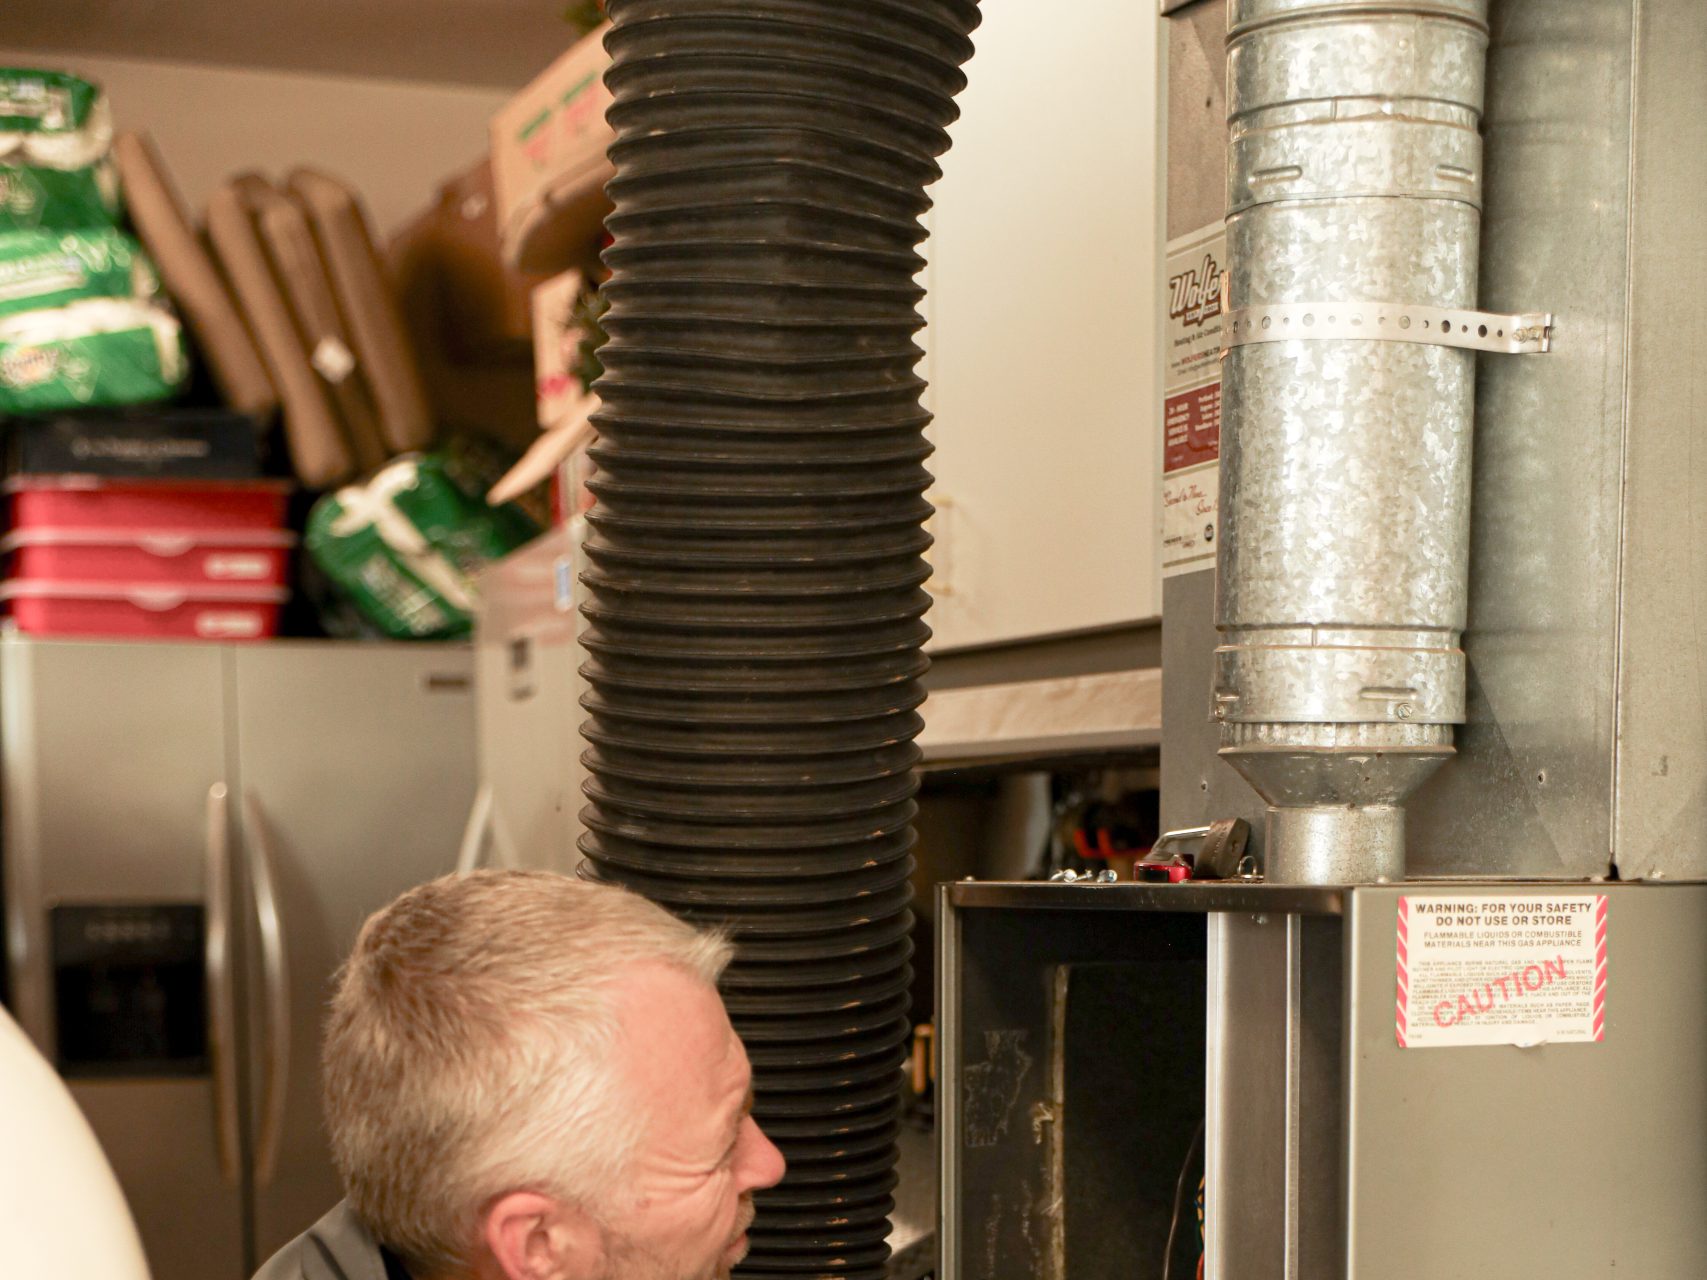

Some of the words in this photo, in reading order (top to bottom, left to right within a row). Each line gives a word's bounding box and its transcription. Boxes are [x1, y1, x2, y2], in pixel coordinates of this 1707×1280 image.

[1415, 903, 1478, 914] WARNING:
[1481, 903, 1506, 914] FOR
[1509, 903, 1543, 914] YOUR
[1546, 903, 1592, 913] SAFETY
[1436, 916, 1453, 926] DO
[1456, 916, 1481, 926] NOT
[1484, 916, 1508, 926] USE
[1512, 916, 1529, 926] OR
[1532, 915, 1572, 926] STORE
[1423, 931, 1474, 940] FLAMMABLE
[1476, 931, 1509, 939] LIQUIDS
[1511, 931, 1522, 939] OR
[1524, 930, 1582, 939] COMBUSTIBLE
[1424, 940, 1471, 949] MATERIALS
[1473, 940, 1496, 948] NEAR
[1497, 940, 1516, 948] THIS
[1517, 940, 1534, 948] GAS
[1536, 939, 1581, 948] APPLIANCE
[1432, 954, 1566, 1028] CAUTION
